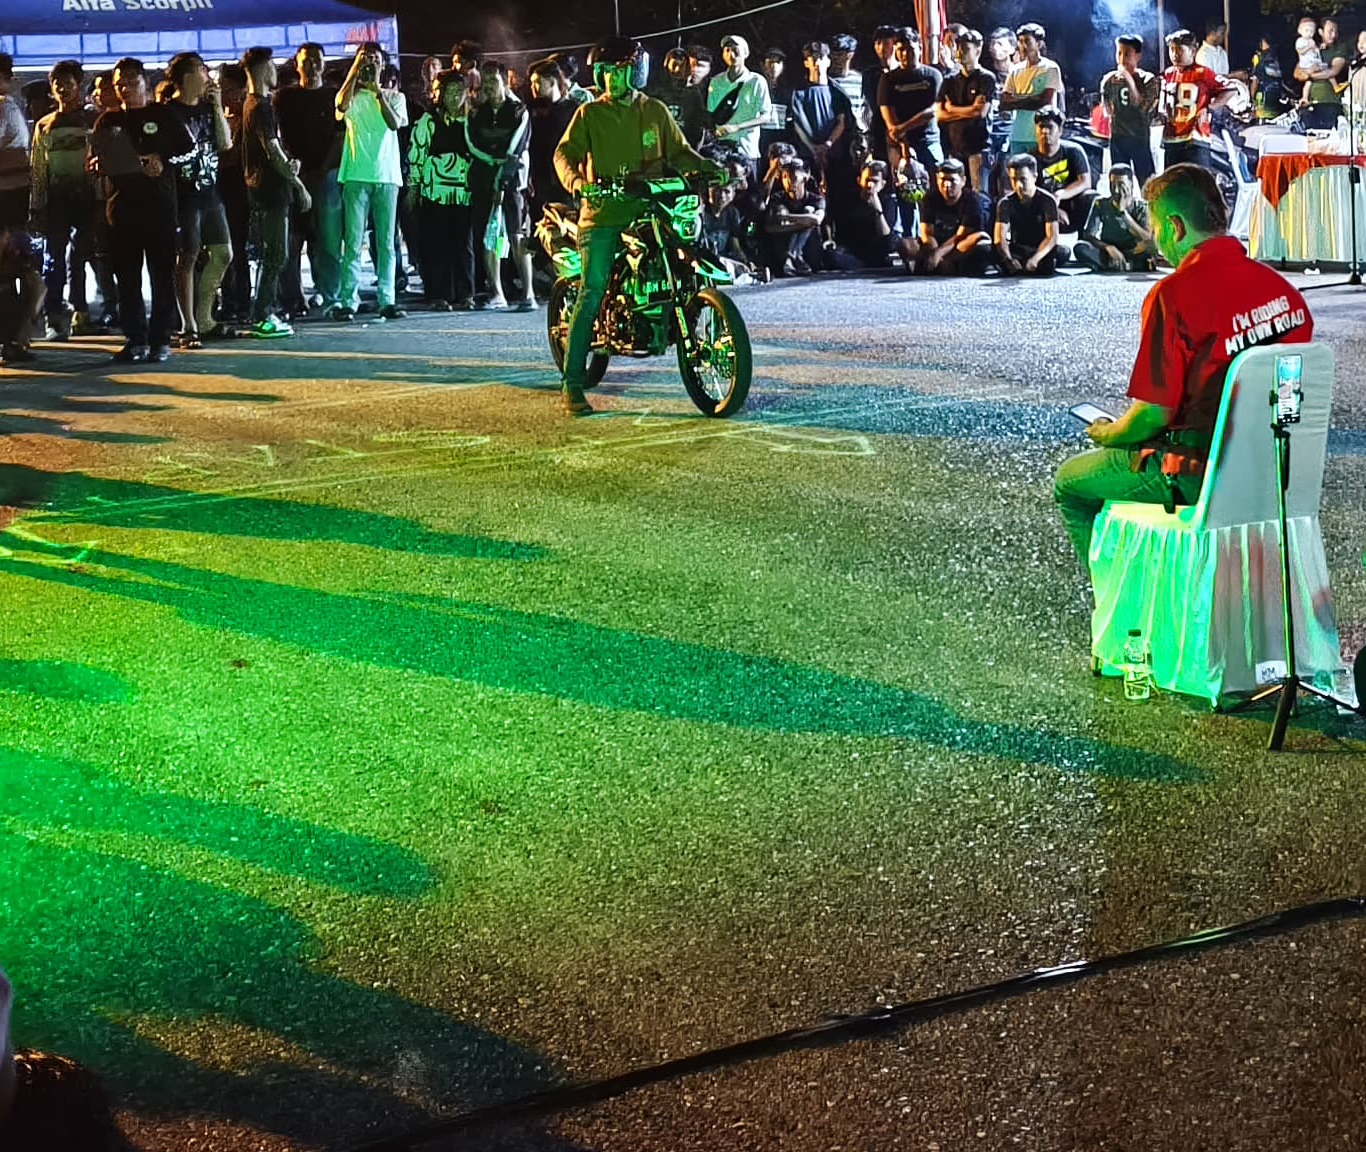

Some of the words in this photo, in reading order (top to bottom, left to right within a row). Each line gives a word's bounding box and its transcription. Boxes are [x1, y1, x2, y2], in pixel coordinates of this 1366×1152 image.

[1224, 331, 1245, 356] MY
[1247, 322, 1273, 345] OWN
[1273, 309, 1306, 334] ROAD
[1232, 312, 1251, 333] I'M
[1251, 295, 1290, 325] RIDING
